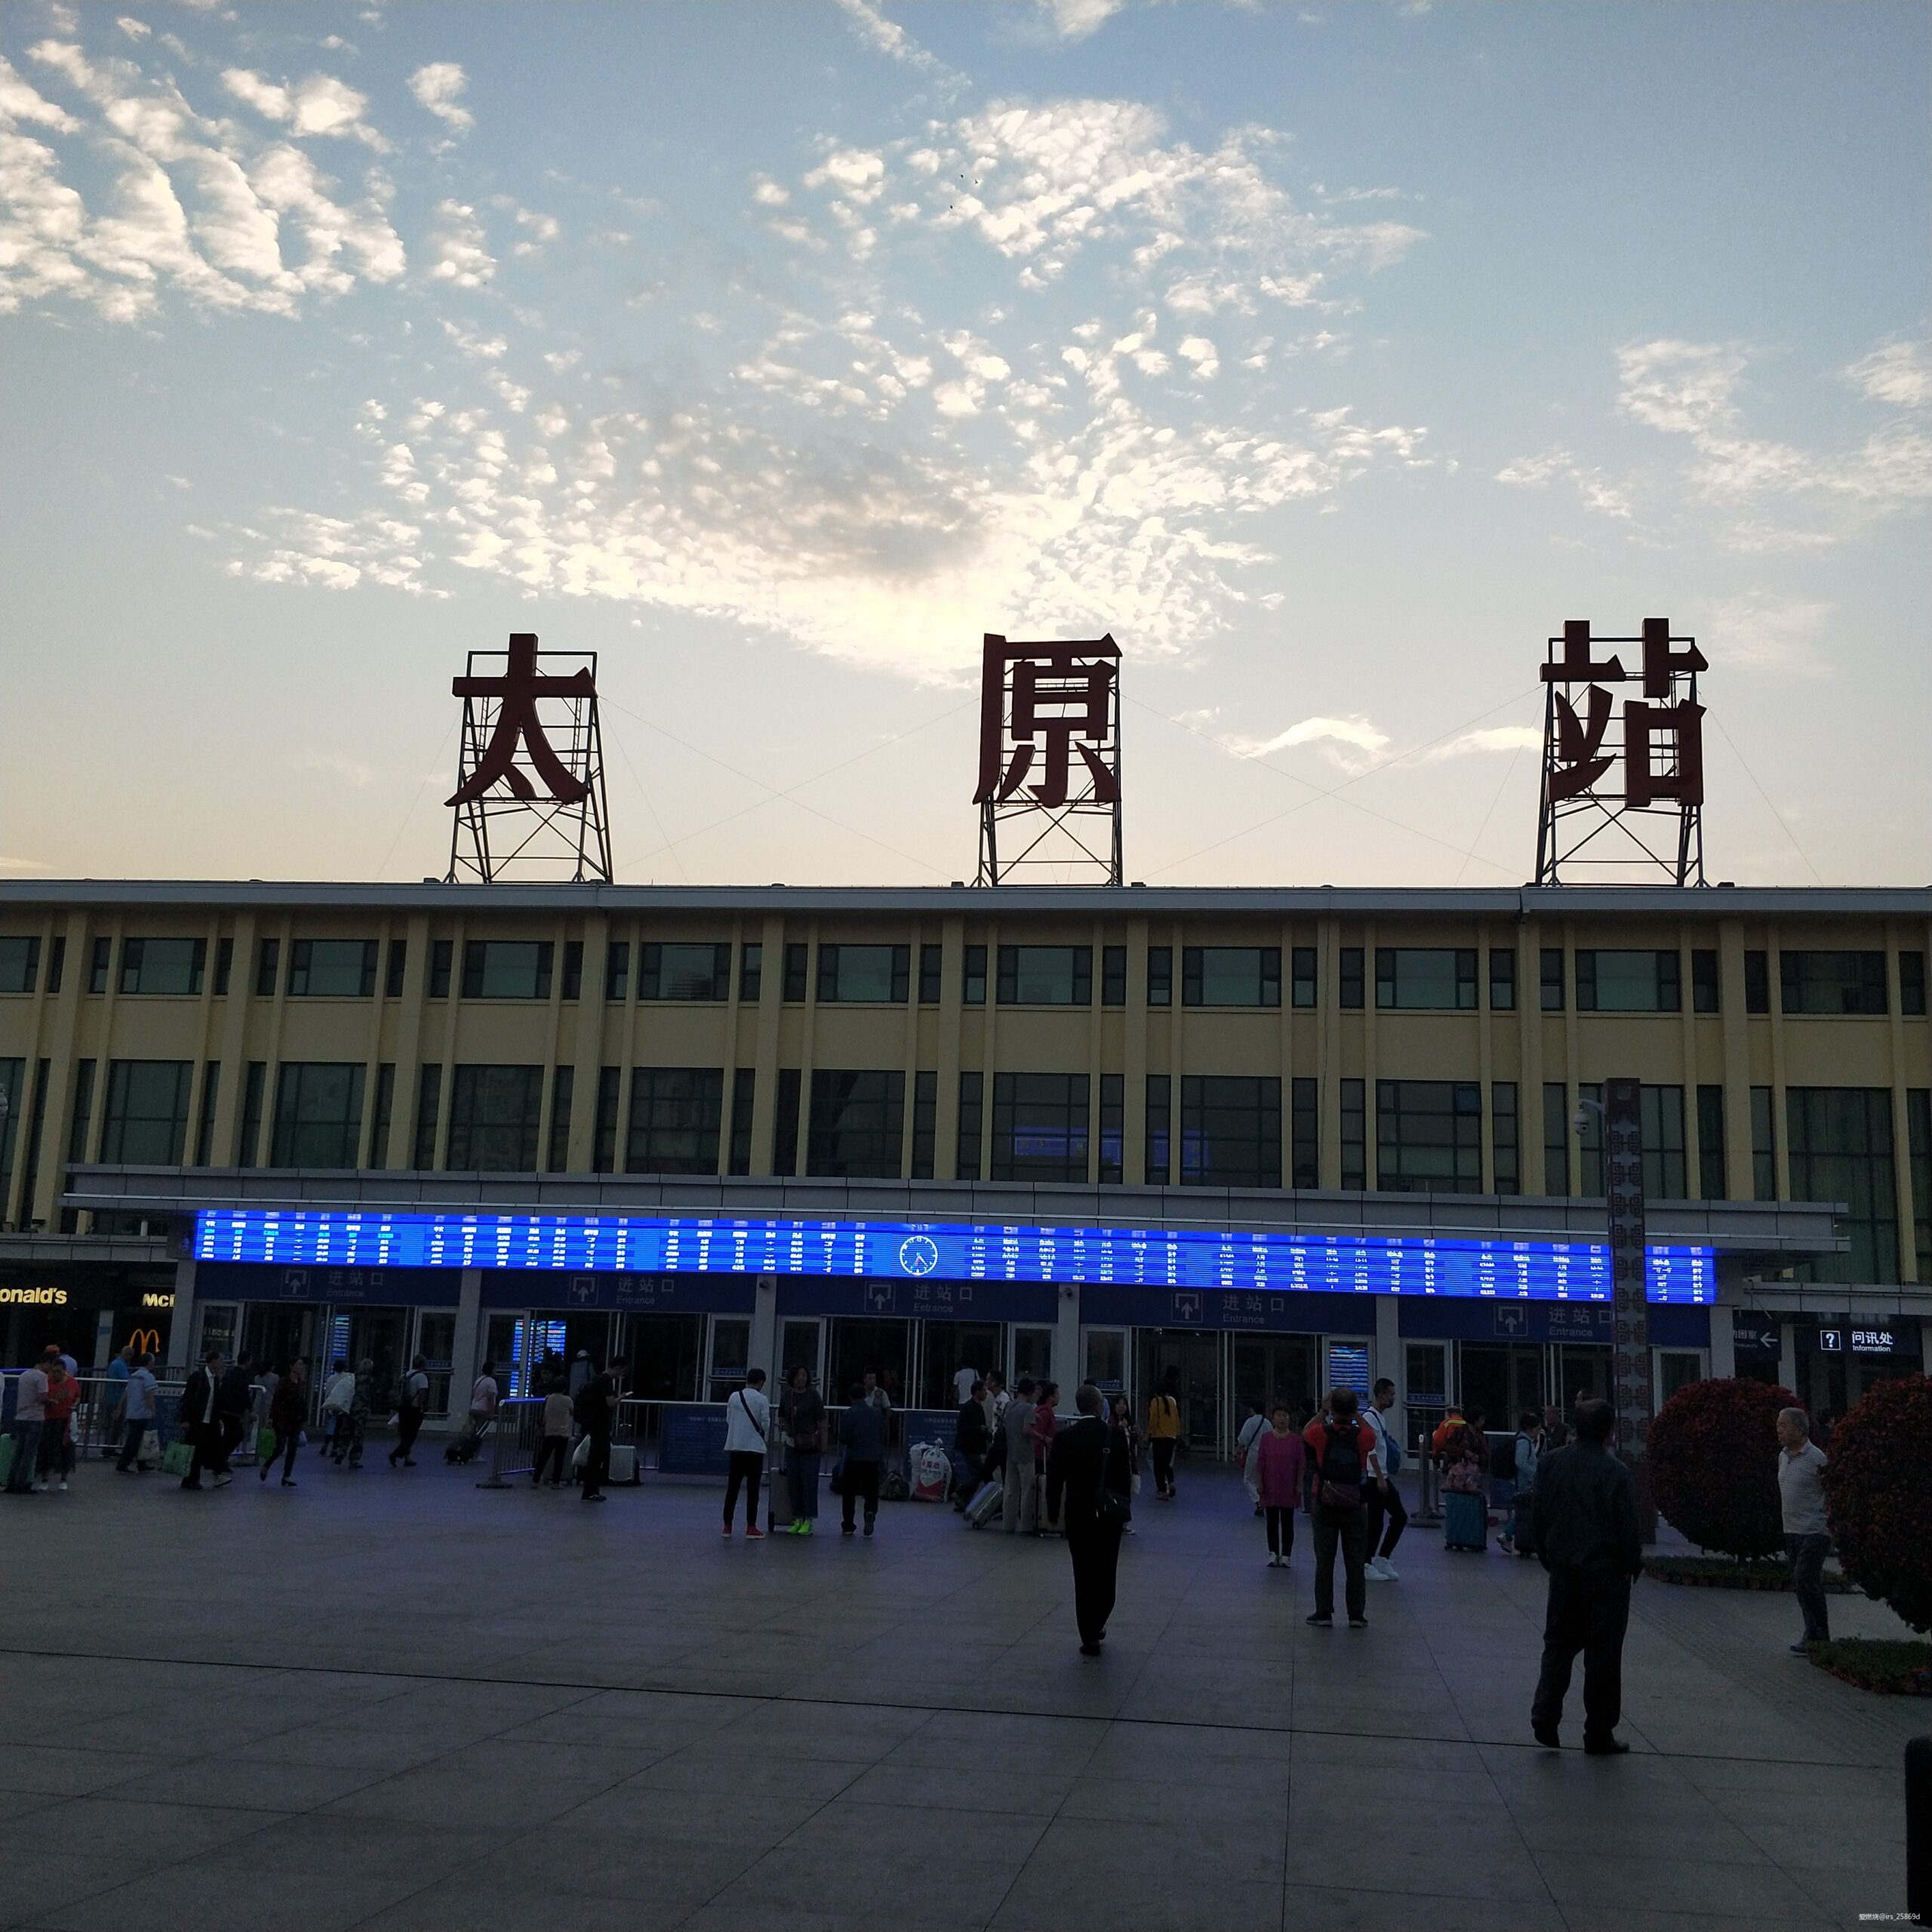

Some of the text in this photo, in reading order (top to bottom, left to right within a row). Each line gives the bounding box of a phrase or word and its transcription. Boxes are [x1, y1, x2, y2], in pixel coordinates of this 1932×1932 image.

[328, 1269, 384, 1286] 进站口
[617, 1276, 675, 1293] 进站口
[327, 1288, 365, 1297] Entrance
[914, 1284, 973, 1301] 进站口
[616, 1295, 656, 1305] Entrance
[1223, 1294, 1284, 1312] 进站口
[913, 1303, 954, 1313] Entrance
[1549, 1306, 1612, 1324] 进站口
[1223, 1313, 1265, 1324] Entrance
[1549, 1327, 1593, 1337] Entrance
[1851, 1331, 1894, 1345] 问讯处
